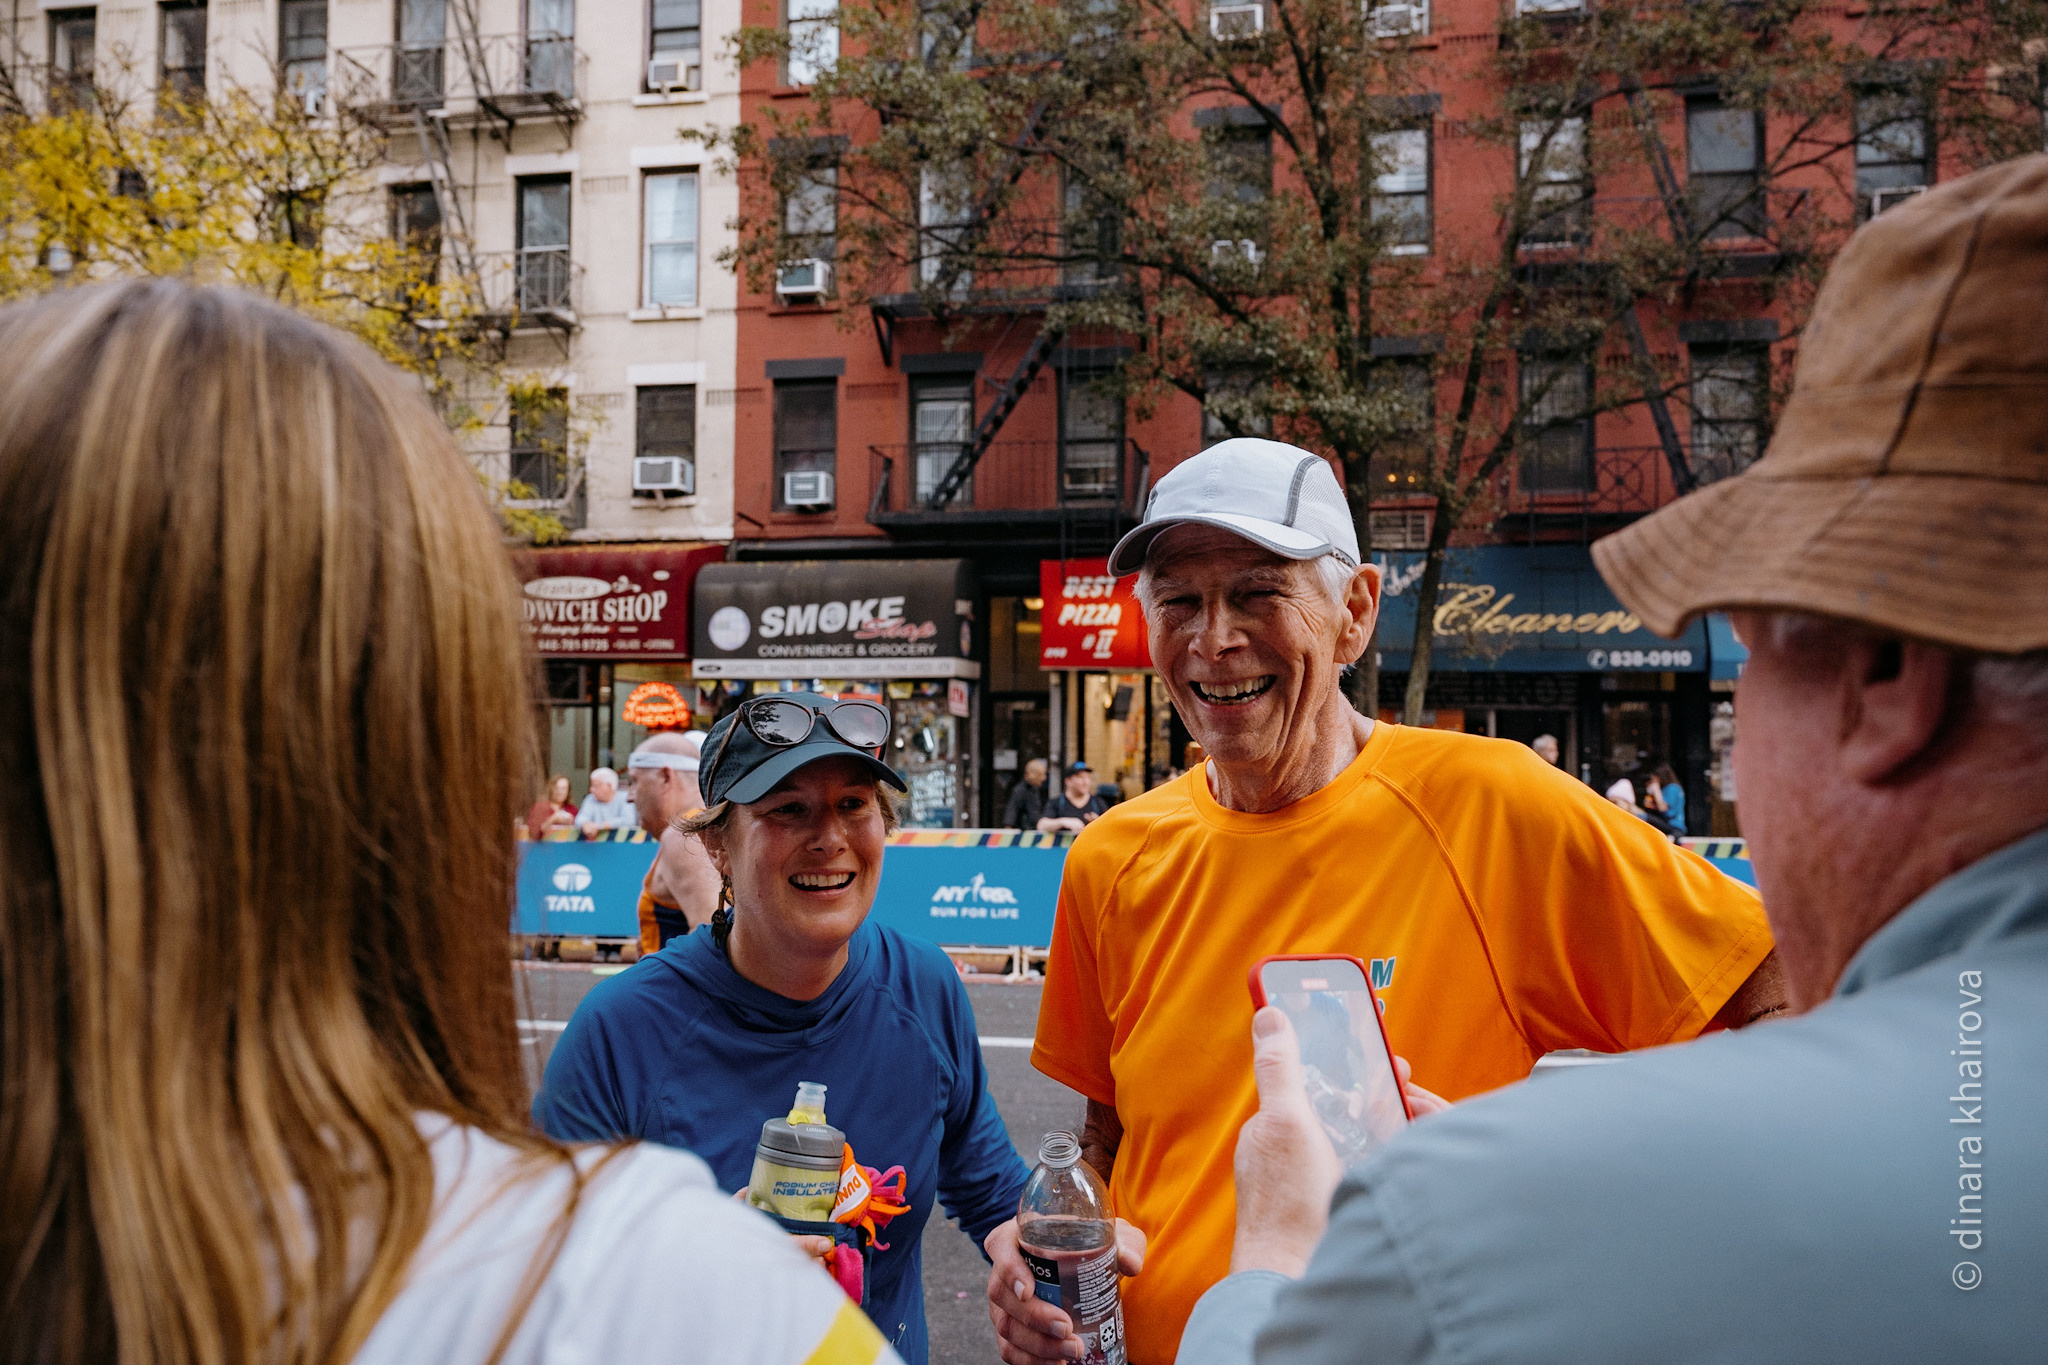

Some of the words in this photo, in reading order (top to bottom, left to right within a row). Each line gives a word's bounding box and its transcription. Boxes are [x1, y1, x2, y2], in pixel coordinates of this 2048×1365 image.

[1062, 575, 1118, 598] BEST
[522, 599, 599, 622] DWICH
[602, 589, 668, 622] SHOP
[758, 595, 906, 638] SMOKE
[1058, 603, 1122, 626] PIZZA
[853, 617, 938, 643] Shop
[757, 643, 855, 657] CONVENIENCE
[856, 643, 867, 656] &
[868, 642, 938, 656] GROCERY
[545, 895, 596, 912] TATA
[930, 906, 958, 918] RUN
[960, 907, 988, 918] FOR
[990, 907, 1019, 919] LIFE
